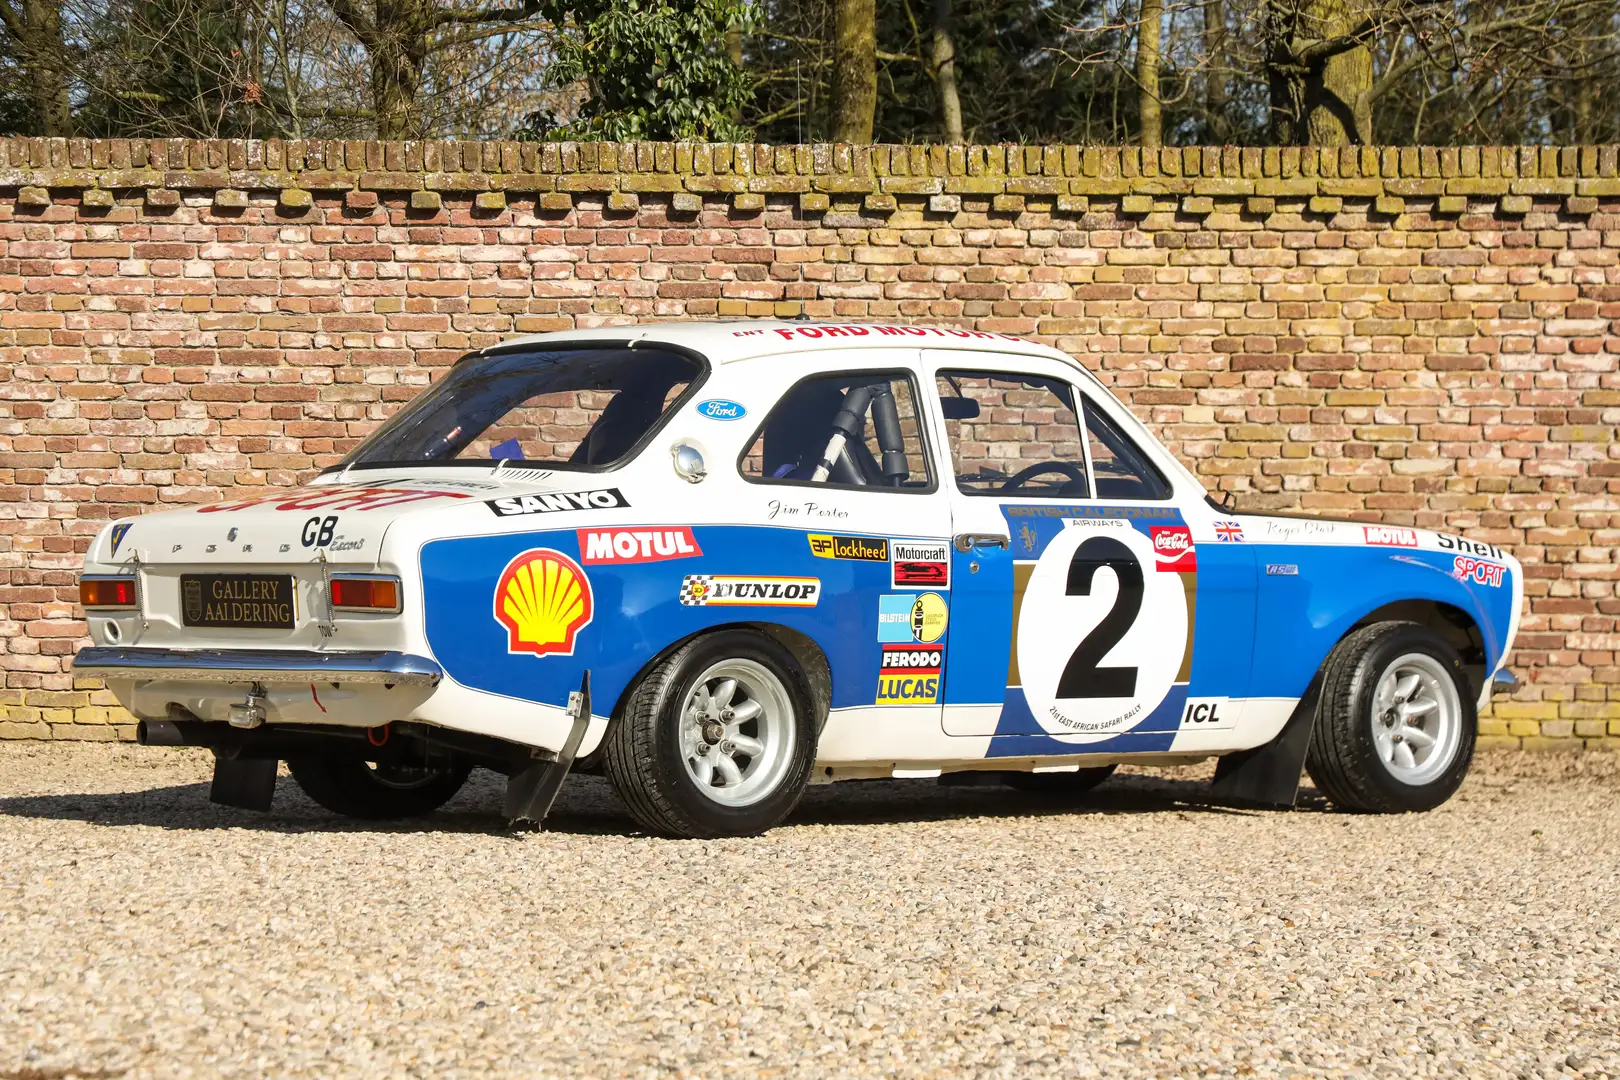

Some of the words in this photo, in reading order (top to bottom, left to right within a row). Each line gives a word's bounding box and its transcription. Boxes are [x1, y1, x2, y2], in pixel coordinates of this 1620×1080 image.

[732, 329, 764, 337] ENT
[773, 326, 869, 340] FORD
[706, 401, 737, 417] Ford
[494, 489, 618, 515] SANYO
[768, 500, 799, 520] Jim
[804, 502, 849, 519] Porter
[1007, 507, 1072, 517] BRITISH
[1072, 508, 1176, 519] CALEDONIAN
[1073, 519, 1124, 527] AIRWAYS
[301, 515, 338, 547] GB
[1367, 527, 1416, 545] MOTUL
[586, 531, 694, 559] MOTUL
[834, 538, 887, 559] Lockheed
[896, 547, 945, 561] Motorcraft
[1437, 534, 1503, 559] Shell
[1455, 557, 1506, 586] SPORT
[212, 580, 280, 600] GALLERY
[712, 583, 816, 599] DUNLOP
[205, 603, 290, 623] AALDERING
[880, 613, 911, 623] BILSTEIN
[1055, 536, 1144, 699] 2
[882, 652, 941, 667] FERODO
[877, 679, 937, 698] LUCAS
[1049, 706, 1061, 720] 21st
[1058, 716, 1073, 727] EAST
[1072, 722, 1100, 730] AFRICAN
[1100, 717, 1123, 729] SAFARI
[1123, 704, 1142, 720] RALLY
[1184, 703, 1220, 723] ICL
